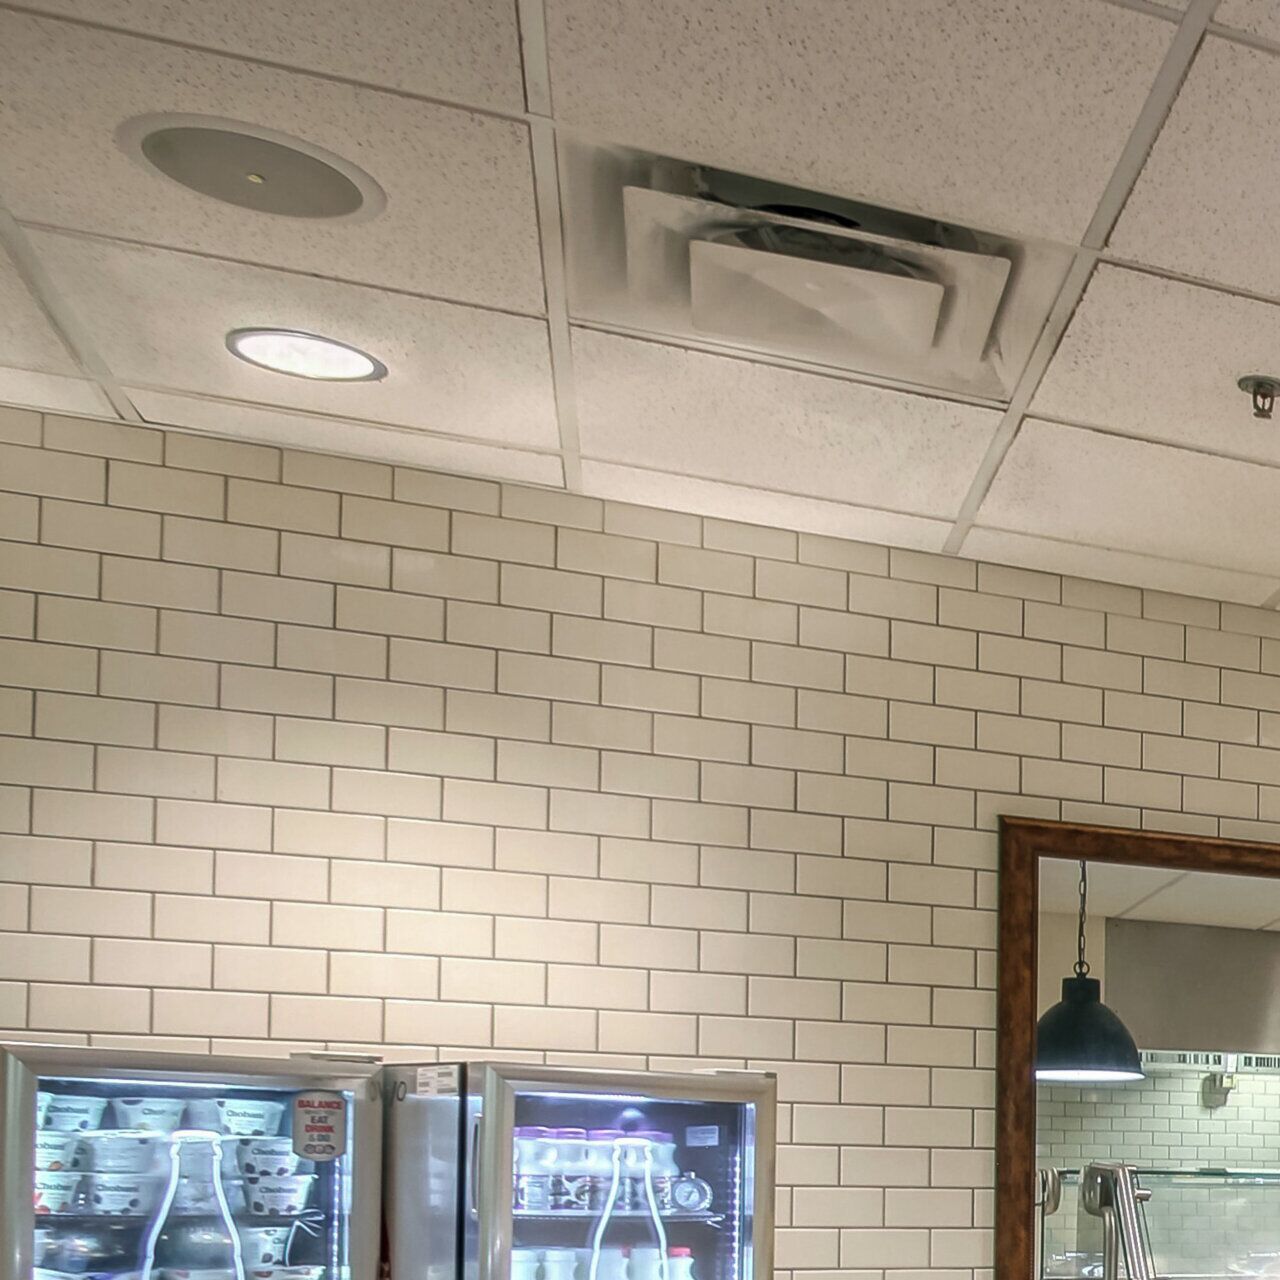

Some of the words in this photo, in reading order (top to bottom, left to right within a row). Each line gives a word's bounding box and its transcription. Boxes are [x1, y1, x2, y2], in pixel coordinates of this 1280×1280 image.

[298, 1099, 342, 1110] BALANCE
[310, 1115, 329, 1124] EAT
[304, 1124, 334, 1133] DRINK
